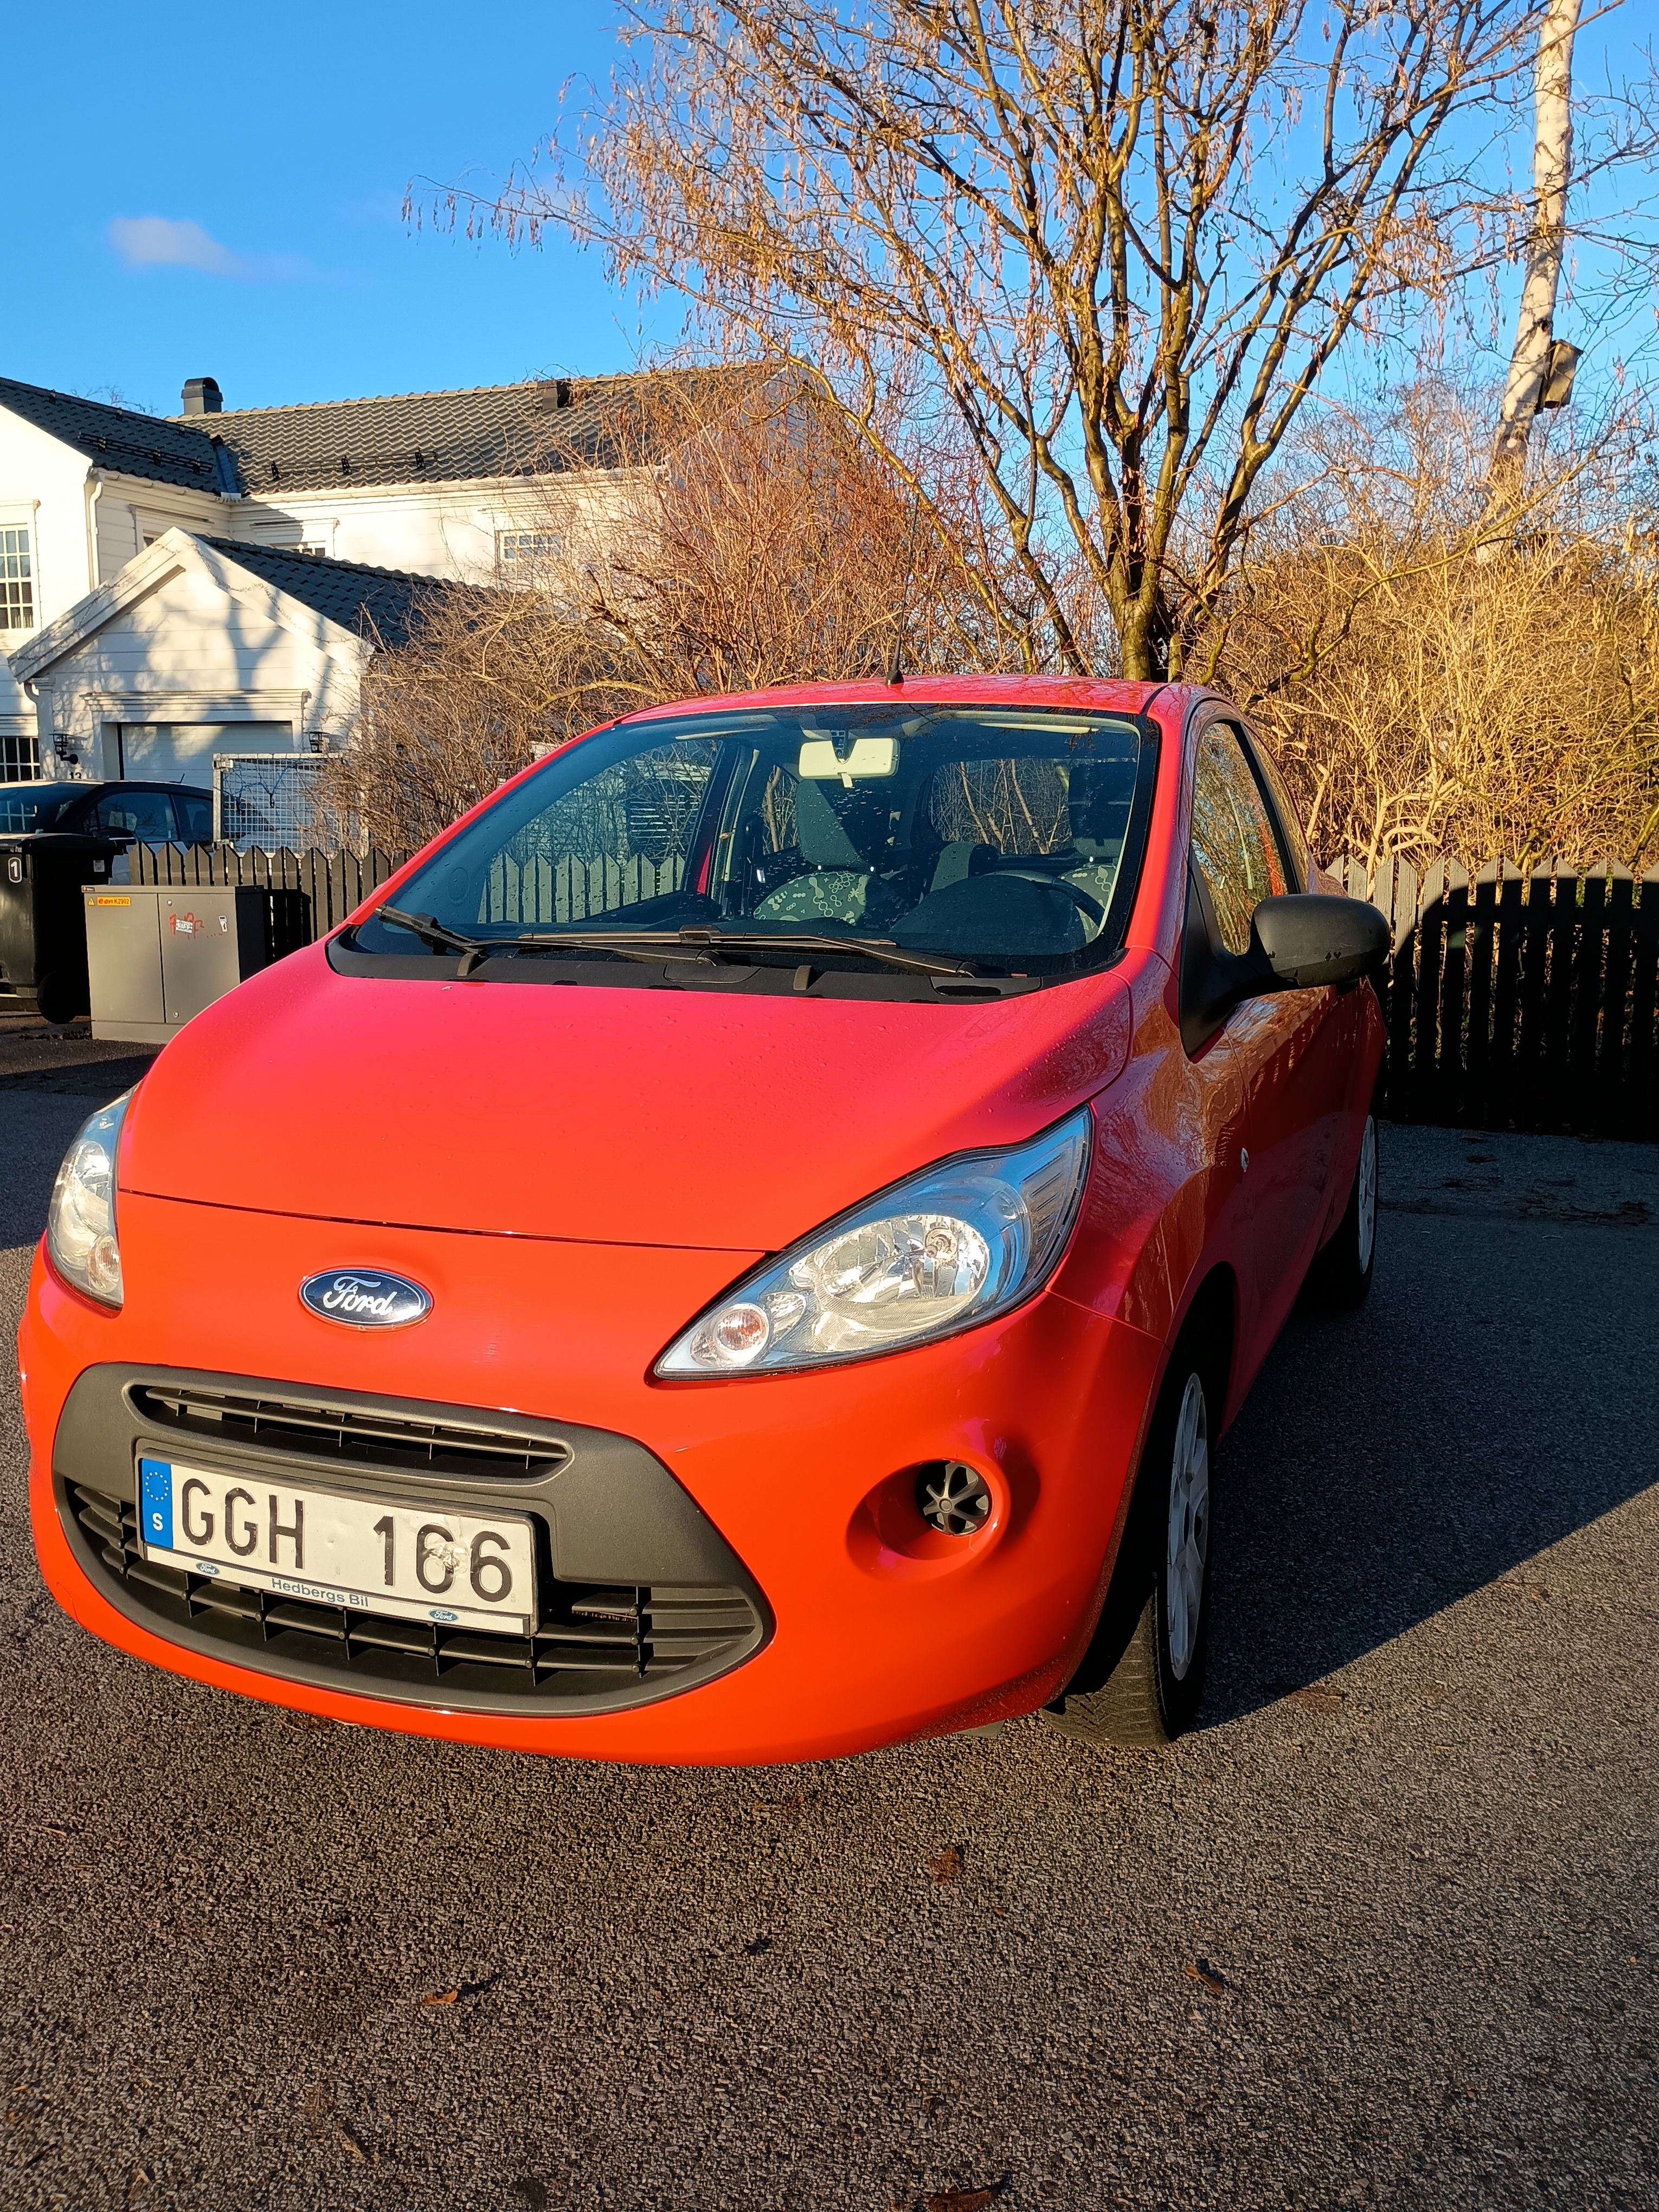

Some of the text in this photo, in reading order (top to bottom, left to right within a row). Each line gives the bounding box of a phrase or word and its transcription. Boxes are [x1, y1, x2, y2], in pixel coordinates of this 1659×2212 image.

[11, 861, 18, 877] 1
[323, 1276, 397, 1316] Ford
[152, 1513, 163, 1531] S
[182, 1478, 512, 1603] GGH 166
[200, 1563, 216, 1574] Ford
[271, 1578, 369, 1607] Hedbergs Bil
[434, 1610, 453, 1621] Ford
